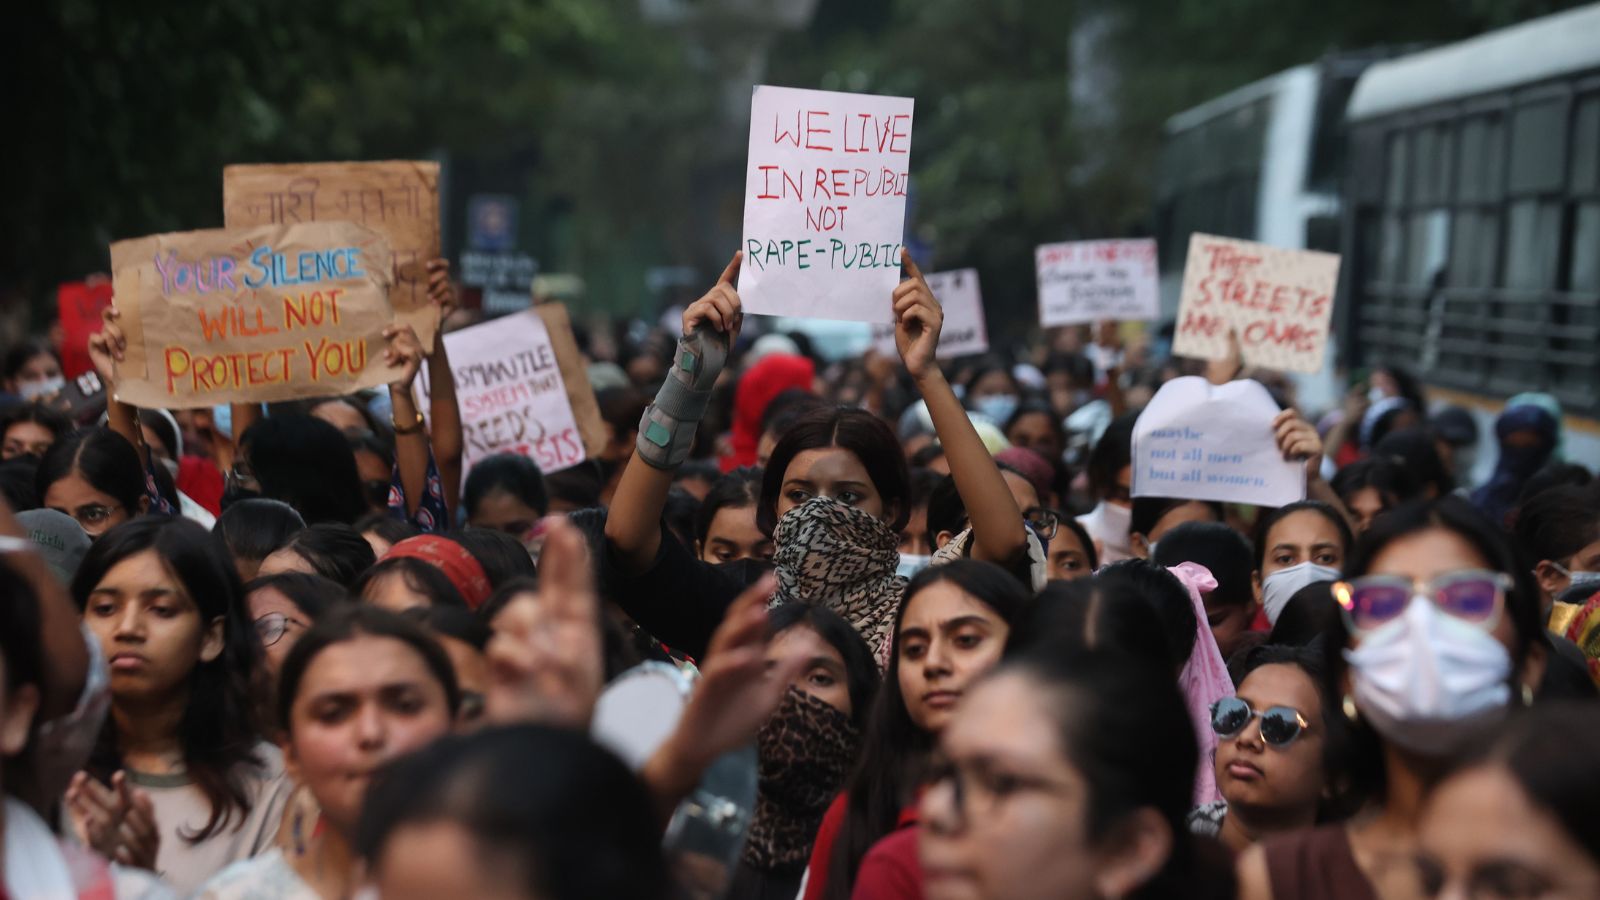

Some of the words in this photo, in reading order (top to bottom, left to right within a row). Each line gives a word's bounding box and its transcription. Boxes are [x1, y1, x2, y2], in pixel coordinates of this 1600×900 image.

[775, 110, 833, 152] WE
[844, 113, 910, 154] LIVE
[757, 165, 803, 202] IN
[806, 206, 848, 232] NOT
[154, 250, 237, 295] YOUR
[244, 245, 366, 288] SILENCE
[747, 238, 902, 271] RAPE-PUBLIC
[199, 304, 280, 343] WILL
[283, 289, 344, 331] NOT
[1193, 275, 1329, 320] STREETS
[164, 345, 296, 395] PROTECT
[304, 335, 367, 381] YOU
[419, 344, 553, 398] SMANTLE
[461, 405, 547, 459] REEDS
[1149, 468, 1176, 481] but
[1181, 469, 1202, 482] all
[1150, 449, 1176, 460] not
[1182, 448, 1202, 462] all
[1207, 453, 1243, 464] men
